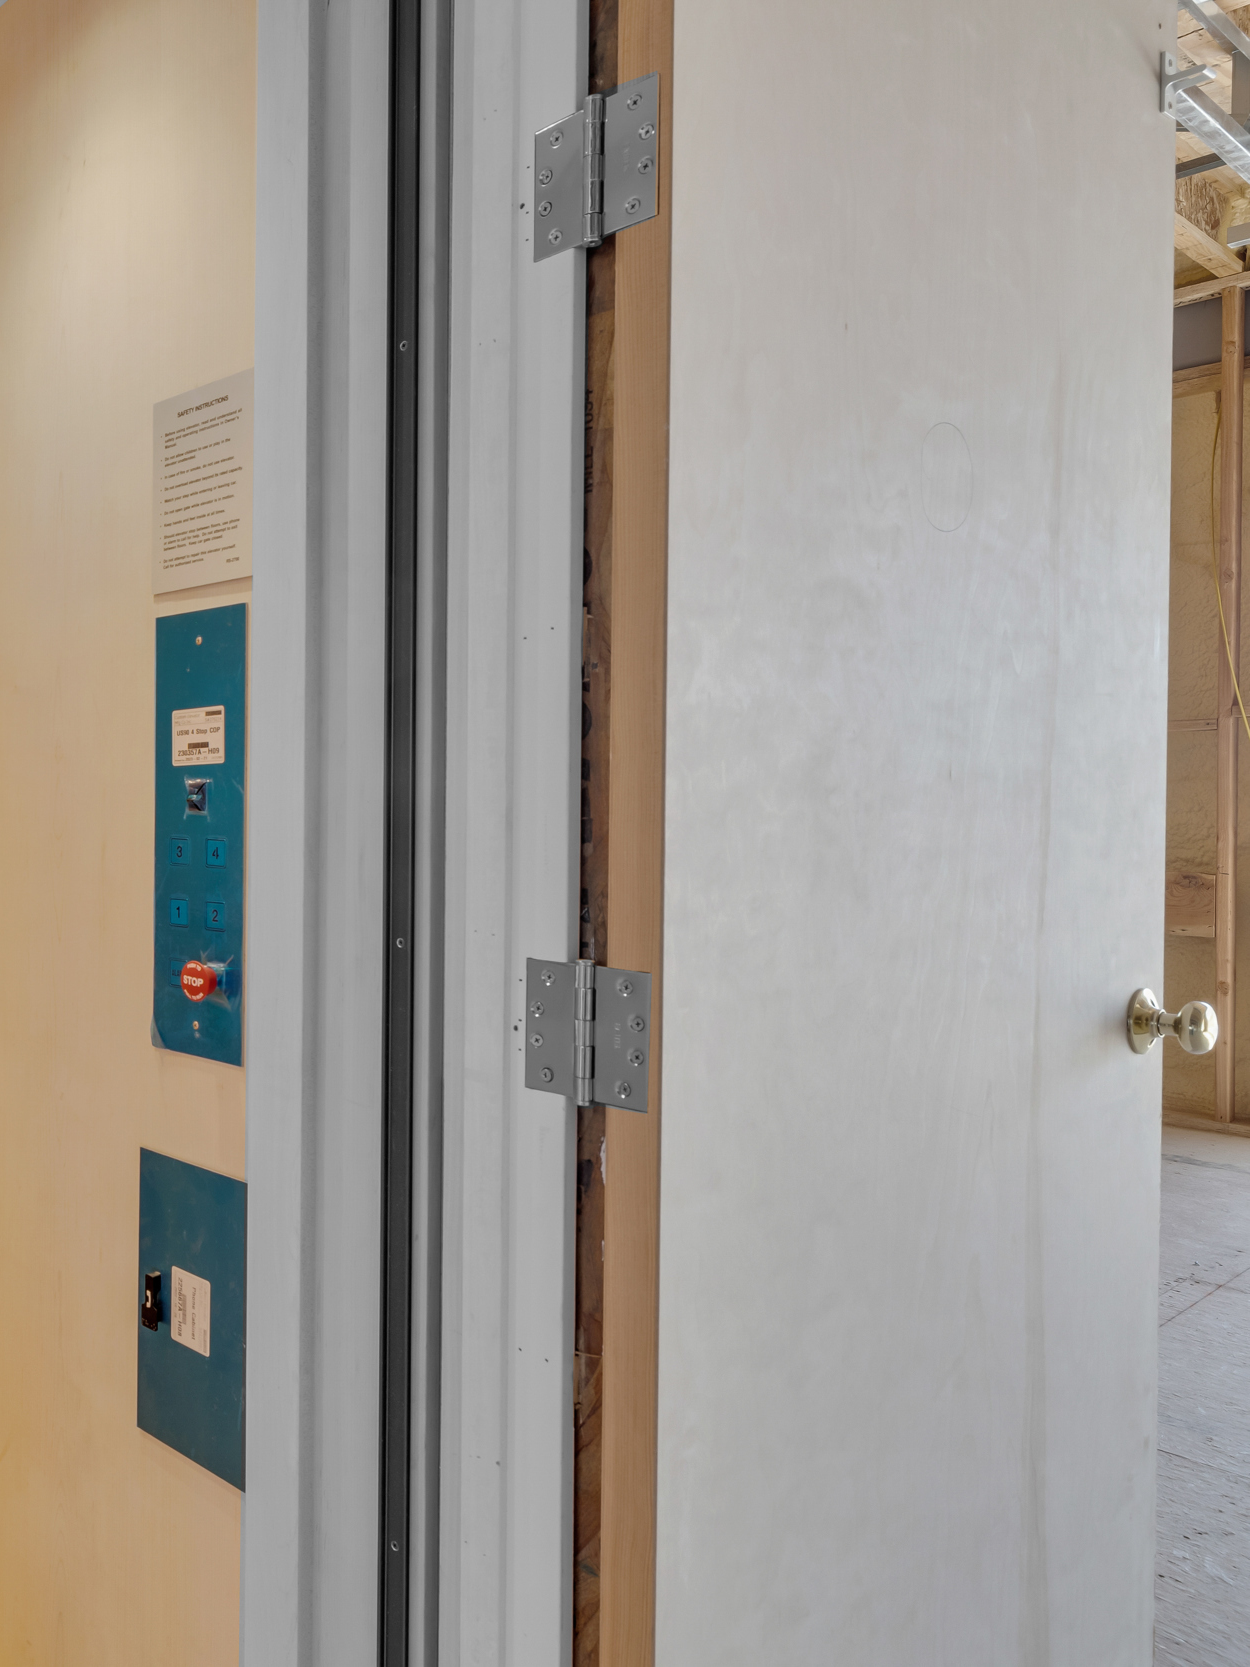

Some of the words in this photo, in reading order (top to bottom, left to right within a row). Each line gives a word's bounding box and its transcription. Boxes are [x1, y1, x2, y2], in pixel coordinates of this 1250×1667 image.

[178, 408, 194, 418] SAFETY
[195, 395, 228, 412] INSTRUCTIONS
[176, 846, 182, 858] 3
[212, 847, 219, 859] 4
[176, 906, 180, 918] 1
[212, 909, 218, 922] 2
[183, 975, 204, 987] STOP
